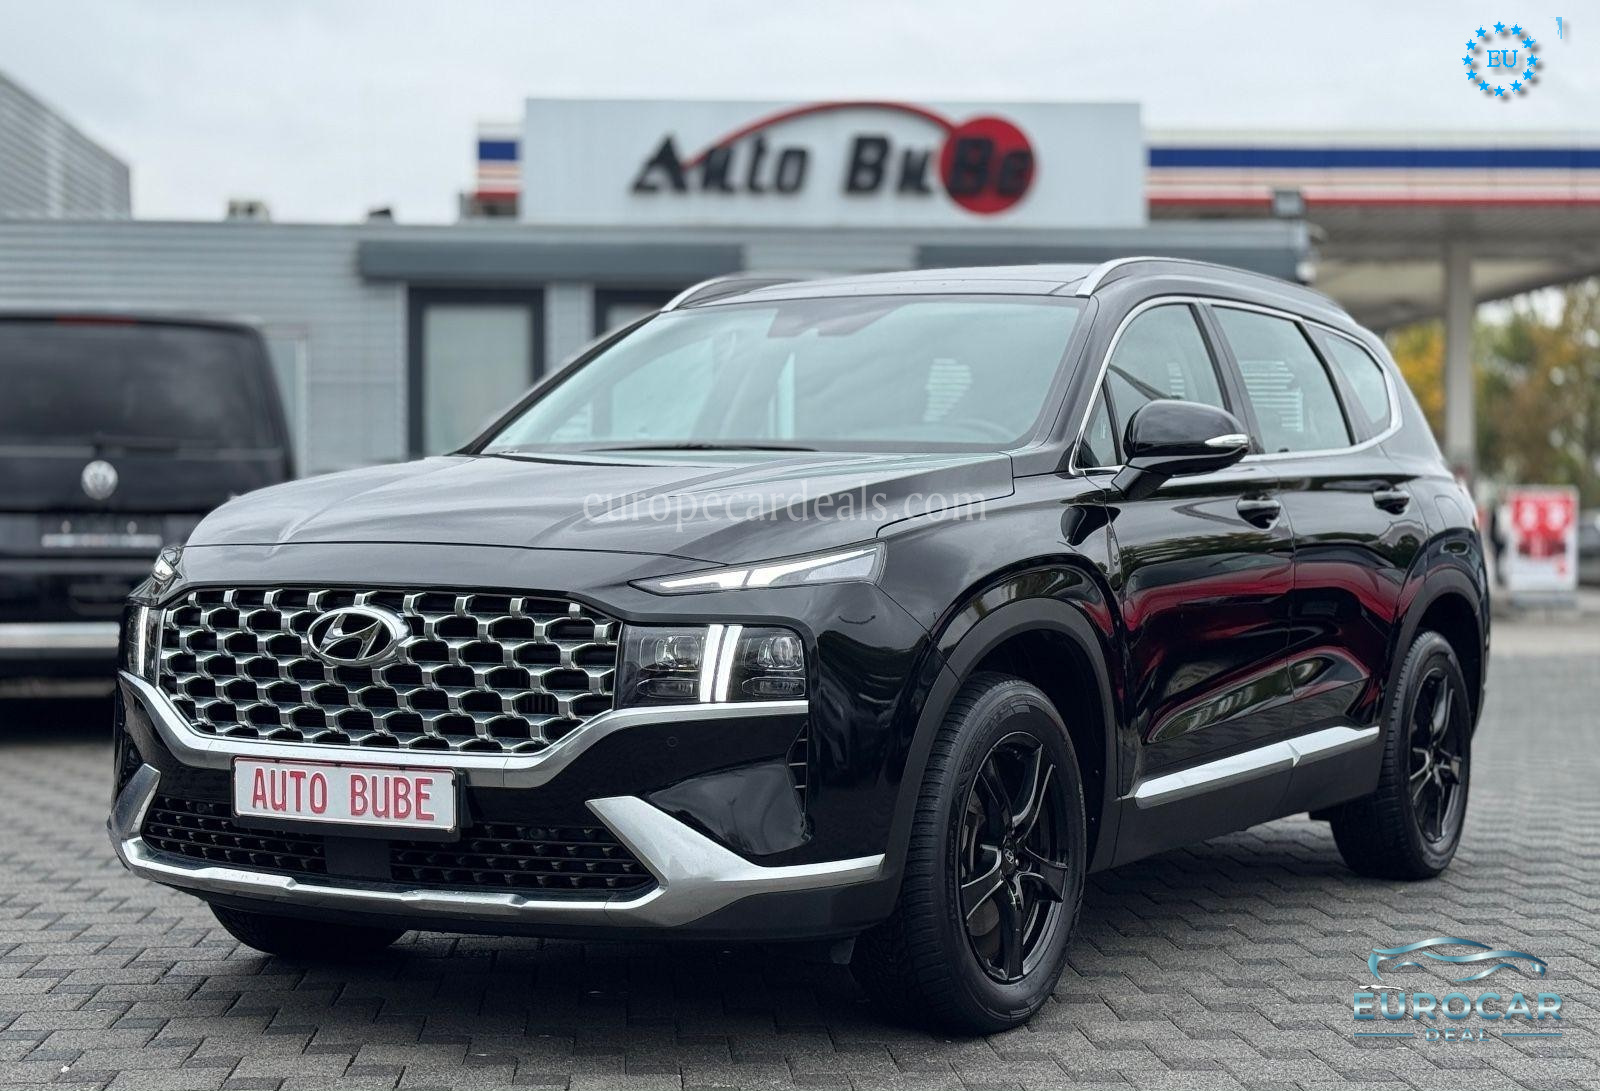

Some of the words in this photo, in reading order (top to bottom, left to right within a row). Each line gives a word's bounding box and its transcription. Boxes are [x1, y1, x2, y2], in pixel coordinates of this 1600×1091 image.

[631, 132, 810, 195] Auto
[252, 767, 328, 815] AUTO
[349, 773, 435, 822] BUBE
